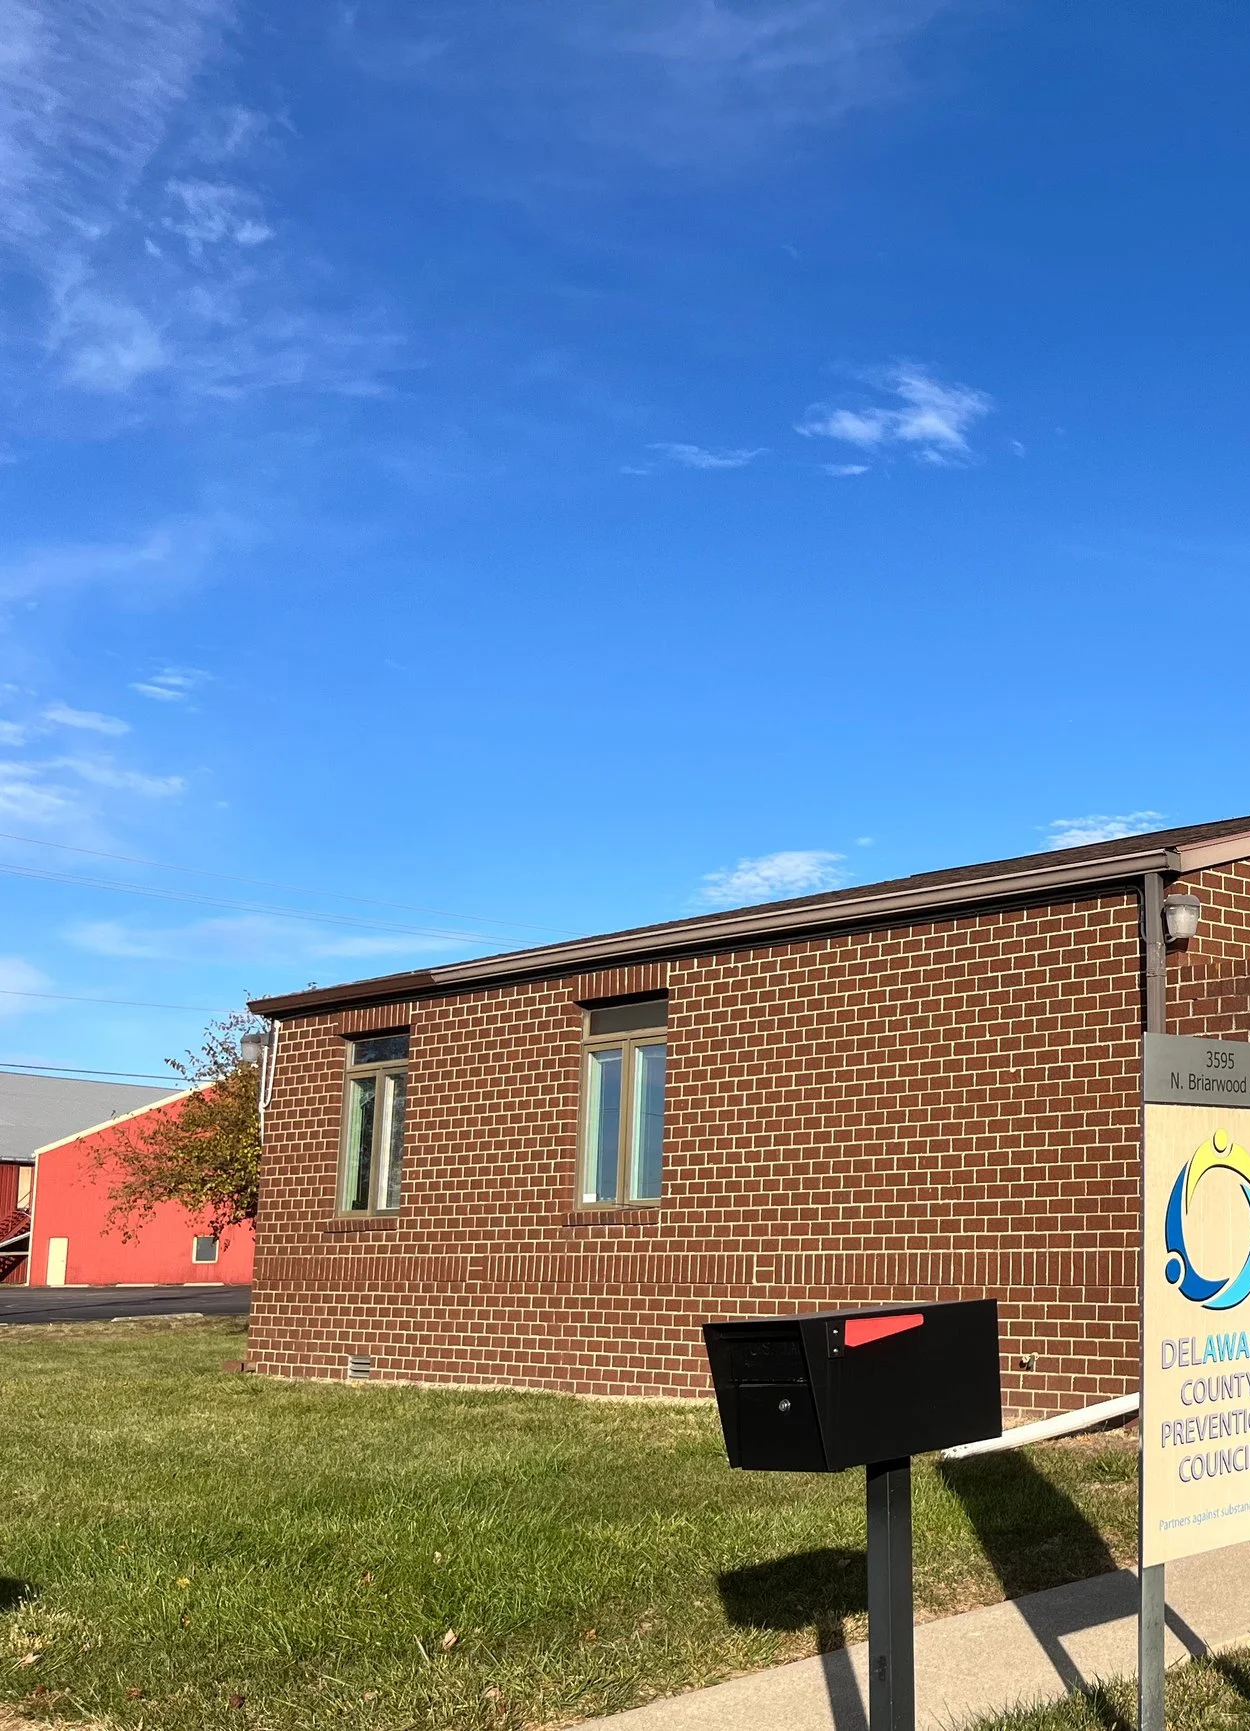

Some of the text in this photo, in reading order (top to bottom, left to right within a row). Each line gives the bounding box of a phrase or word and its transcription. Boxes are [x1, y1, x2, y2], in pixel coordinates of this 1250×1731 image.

[1206, 1050, 1235, 1070] 3595
[1170, 1071, 1184, 1090] N.
[1188, 1073, 1247, 1094] Briarwood
[1159, 1515, 1191, 1531] Partners
[1192, 1508, 1220, 1526] against
